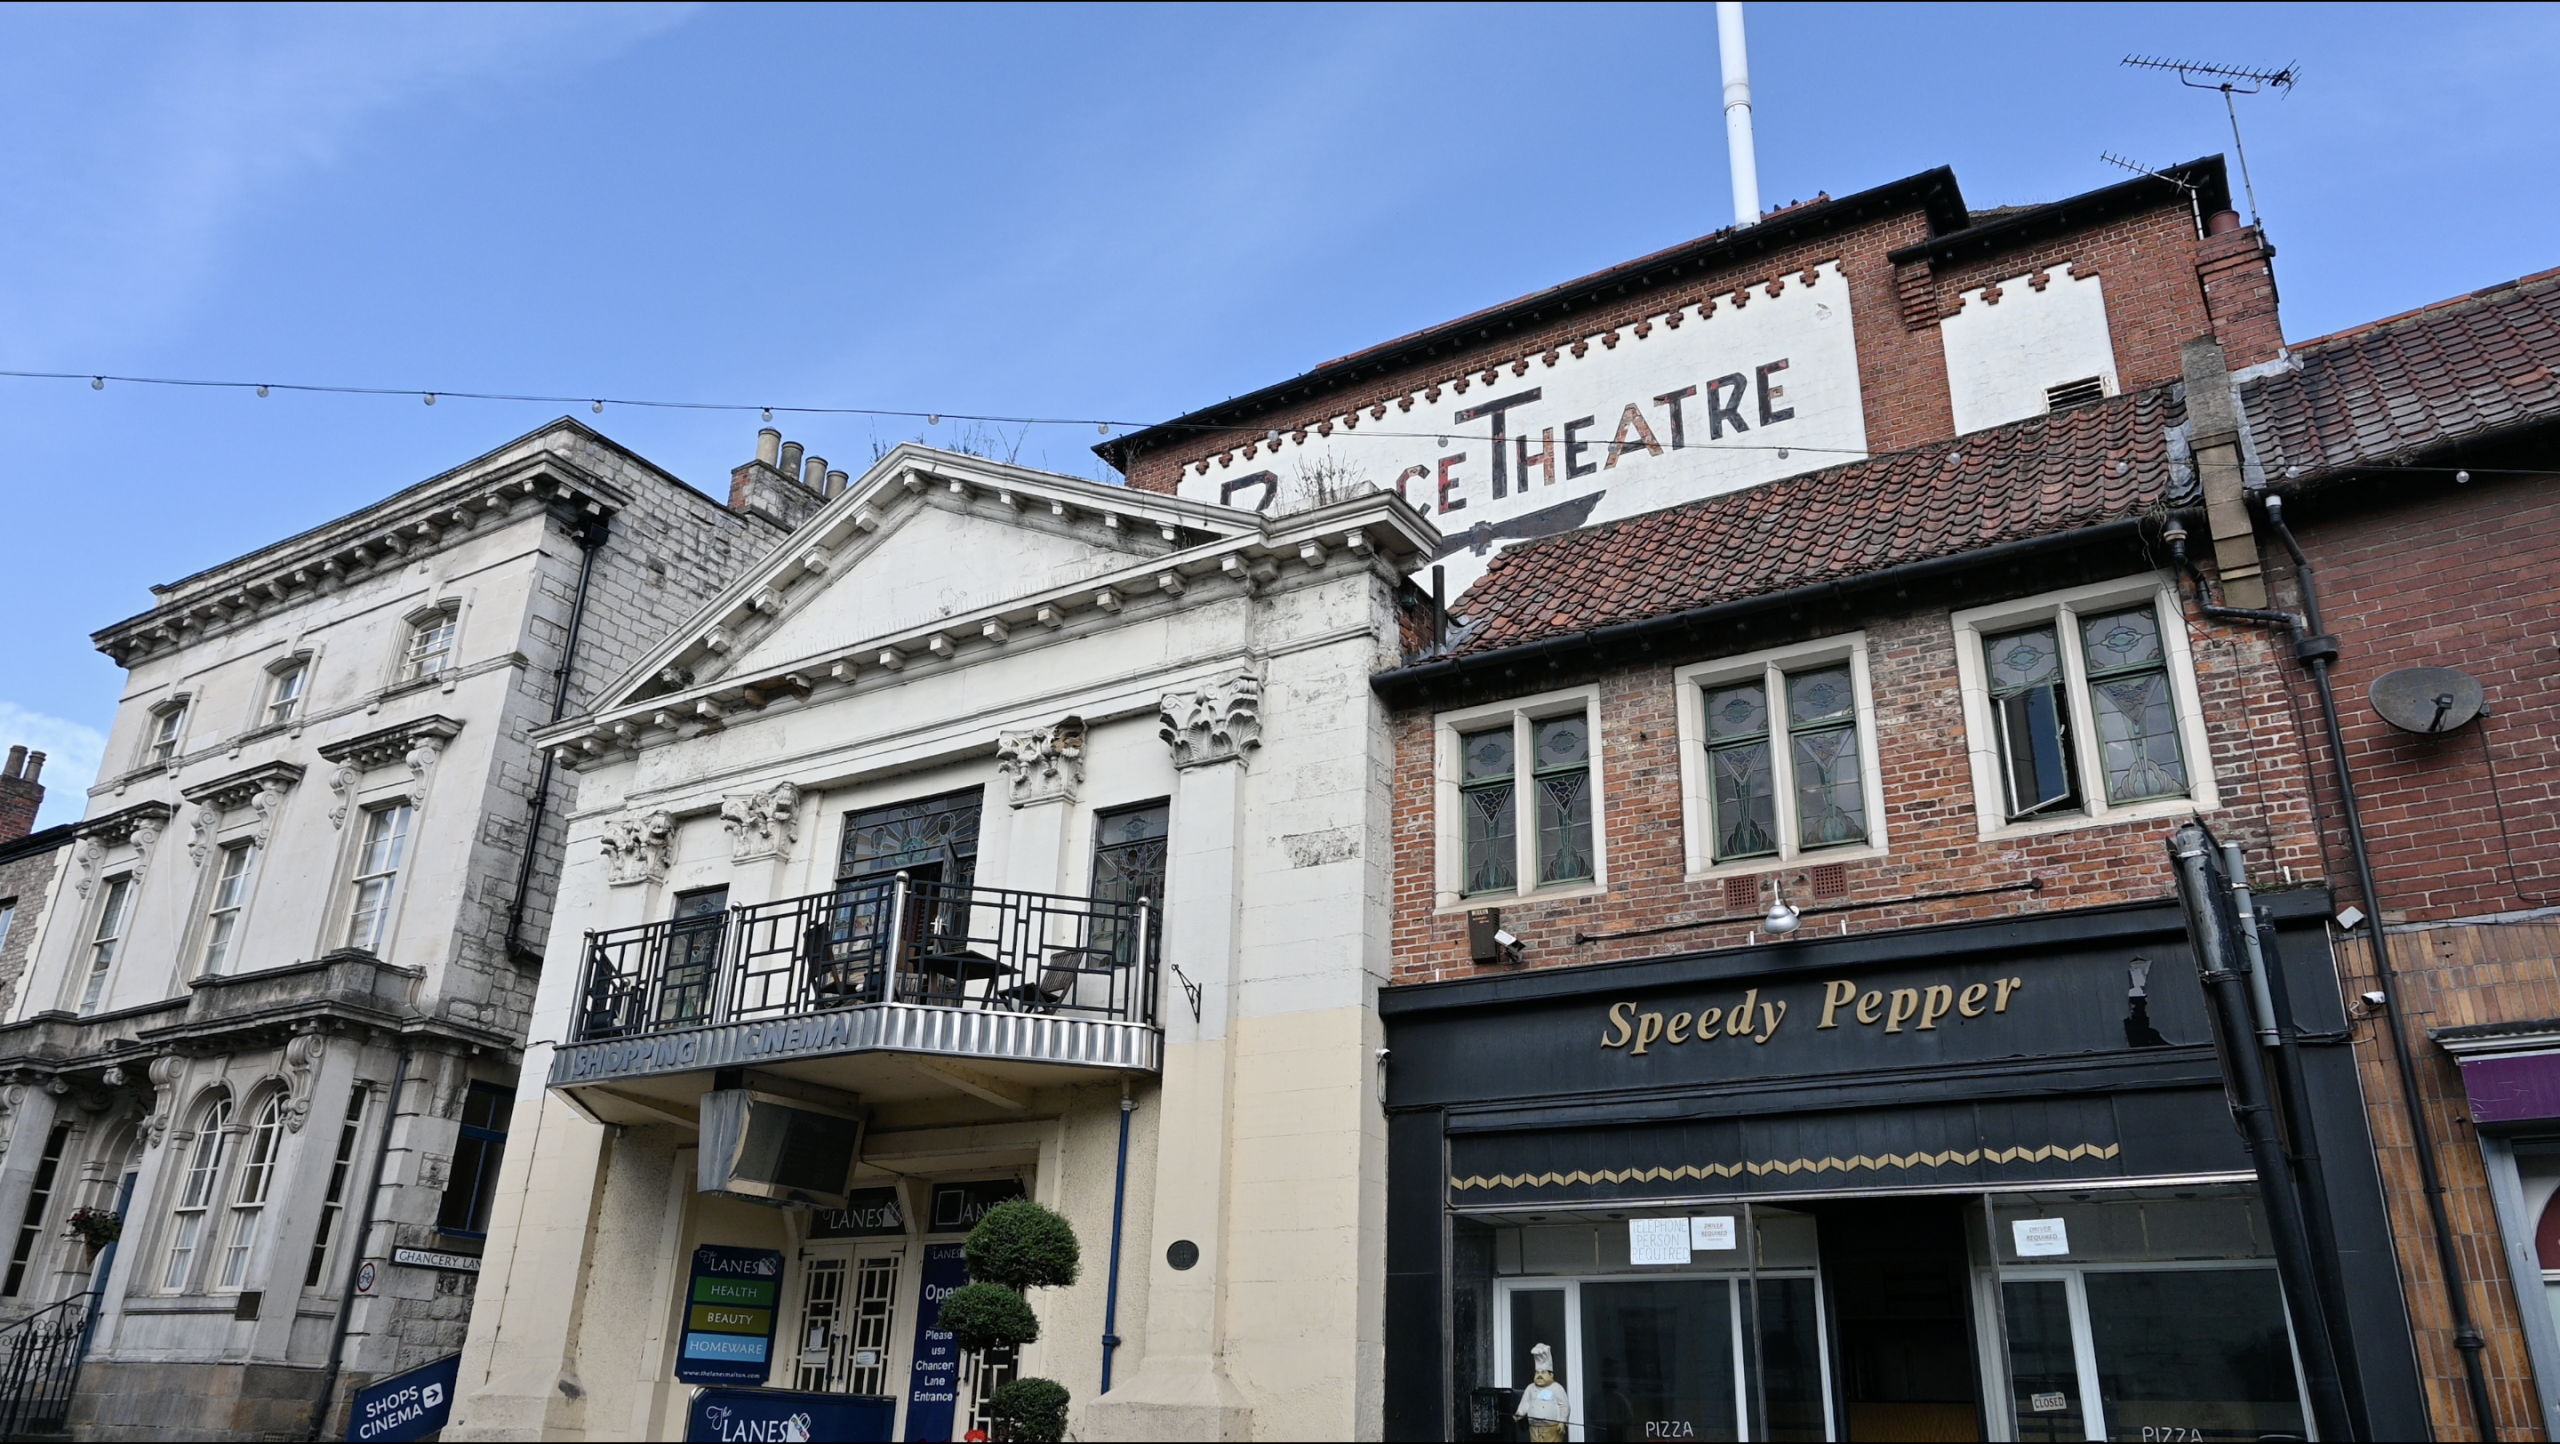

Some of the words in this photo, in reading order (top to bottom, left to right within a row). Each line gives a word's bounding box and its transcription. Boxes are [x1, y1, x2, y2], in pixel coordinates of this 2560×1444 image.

[1454, 358, 1795, 500] THEATRE
[1601, 989, 1787, 1055] Speedy
[1817, 977, 2022, 1033] Pepper
[573, 1038, 698, 1076] SHOPPING
[741, 1018, 850, 1054] CINEMA
[830, 1208, 884, 1230] LANES
[1631, 1219, 1688, 1234] TELEPHONE
[1637, 1234, 1680, 1247] PERSON
[400, 1251, 459, 1267] CHANCERY
[462, 1259, 483, 1270] LAN
[933, 1248, 962, 1260] LANES
[1632, 1247, 1690, 1261] REQUIRED
[710, 1258, 759, 1274] LANES
[711, 1285, 757, 1297] HEALTH
[707, 1312, 753, 1325] BEAUTY
[925, 1330, 953, 1340] Please
[689, 1340, 762, 1355] HOMEWARE
[931, 1347, 946, 1355] use
[683, 1370, 760, 1379] www.thelanesmalton.com
[924, 1375, 946, 1386] Lane
[366, 1385, 419, 1418] SHOPS
[914, 1391, 953, 1402] Entrance
[2034, 1397, 2065, 1409] CLOSED
[359, 1403, 424, 1439] CINEMA
[706, 1406, 732, 1431] The
[722, 1419, 789, 1442] LANES
[1645, 1421, 1694, 1438] PIZZA
[2142, 1426, 2203, 1442] PIZZA
